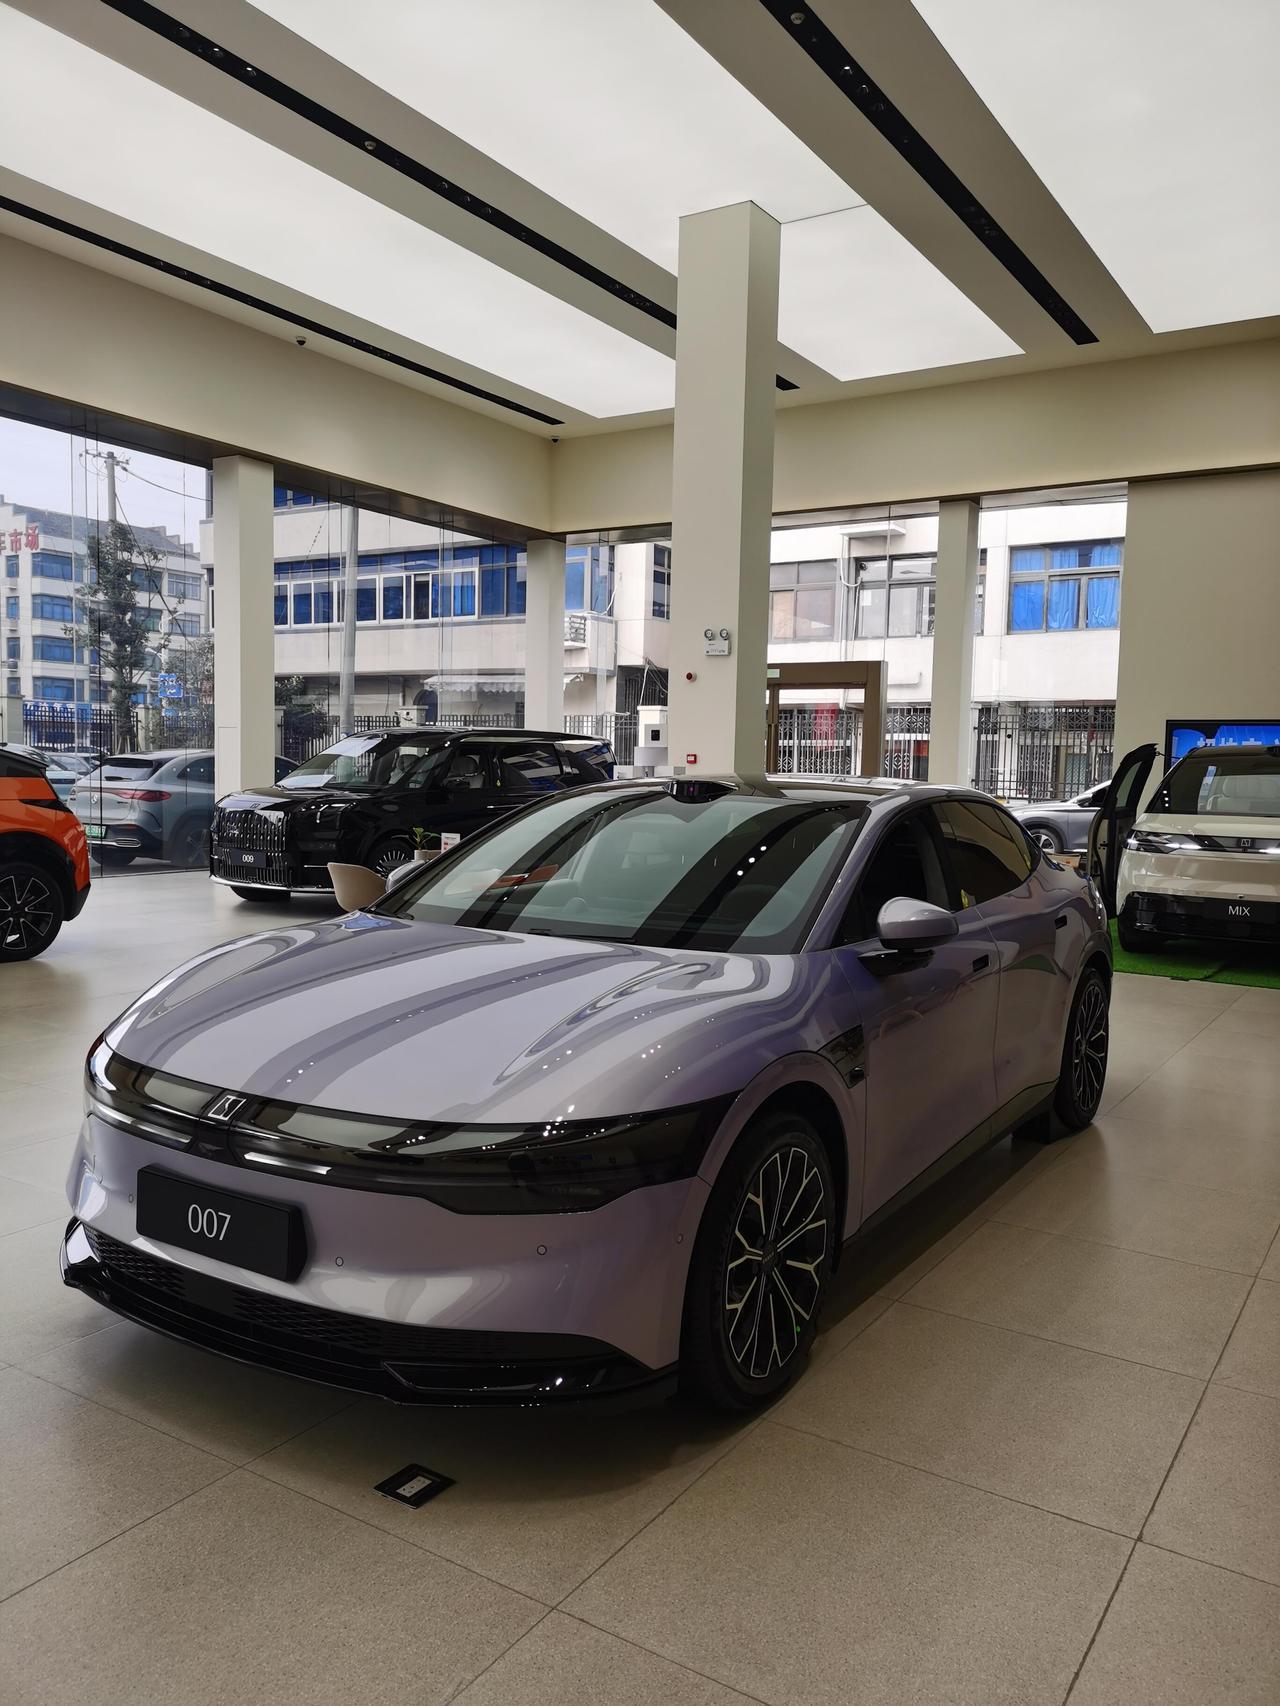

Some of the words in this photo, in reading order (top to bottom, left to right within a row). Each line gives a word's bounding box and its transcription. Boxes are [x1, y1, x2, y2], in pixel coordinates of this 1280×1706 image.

[242, 854, 254, 863] 009
[1228, 905, 1250, 917] MIX
[188, 1204, 231, 1241] 007
